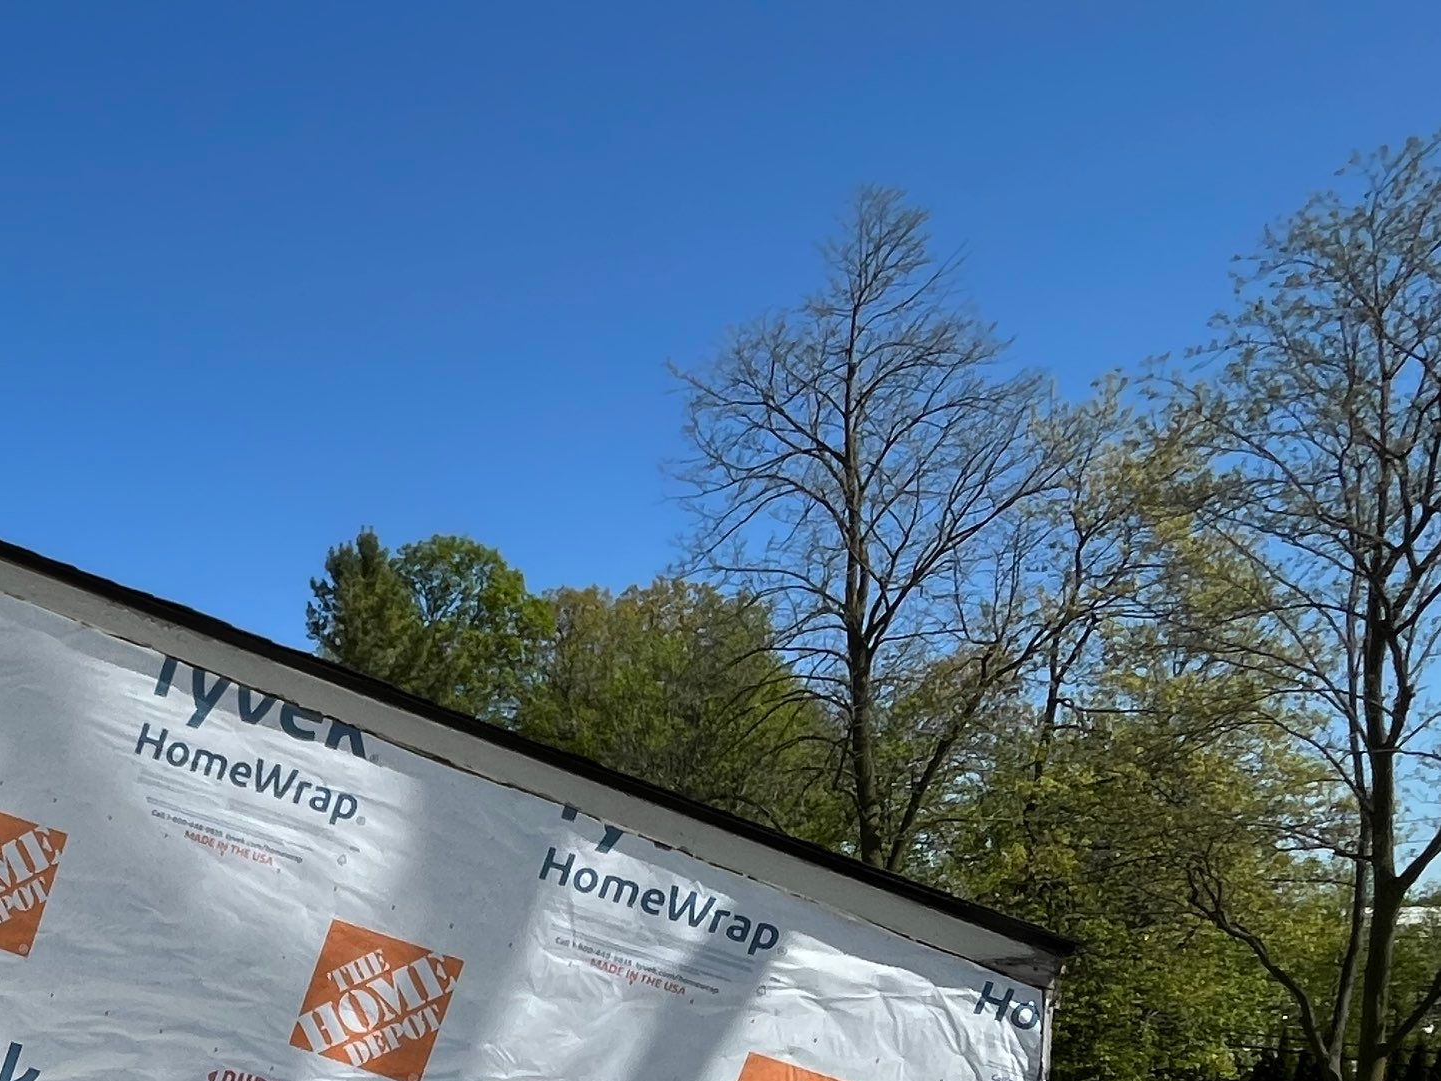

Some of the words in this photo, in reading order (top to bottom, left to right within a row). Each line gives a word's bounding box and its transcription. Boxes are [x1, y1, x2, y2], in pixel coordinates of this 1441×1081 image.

[135, 722, 359, 825] HomeWrap
[183, 829, 215, 847] MADE
[216, 841, 229, 852] IN
[229, 844, 250, 858] THE
[251, 851, 273, 866] USA
[538, 847, 780, 955] HomeWrap
[326, 949, 390, 992] THE
[589, 957, 625, 976] MADE
[625, 969, 638, 980] IN
[639, 973, 661, 987] THE
[663, 979, 687, 995] USA
[298, 953, 458, 1053] HOME
[343, 1004, 442, 1067] DEPOT
